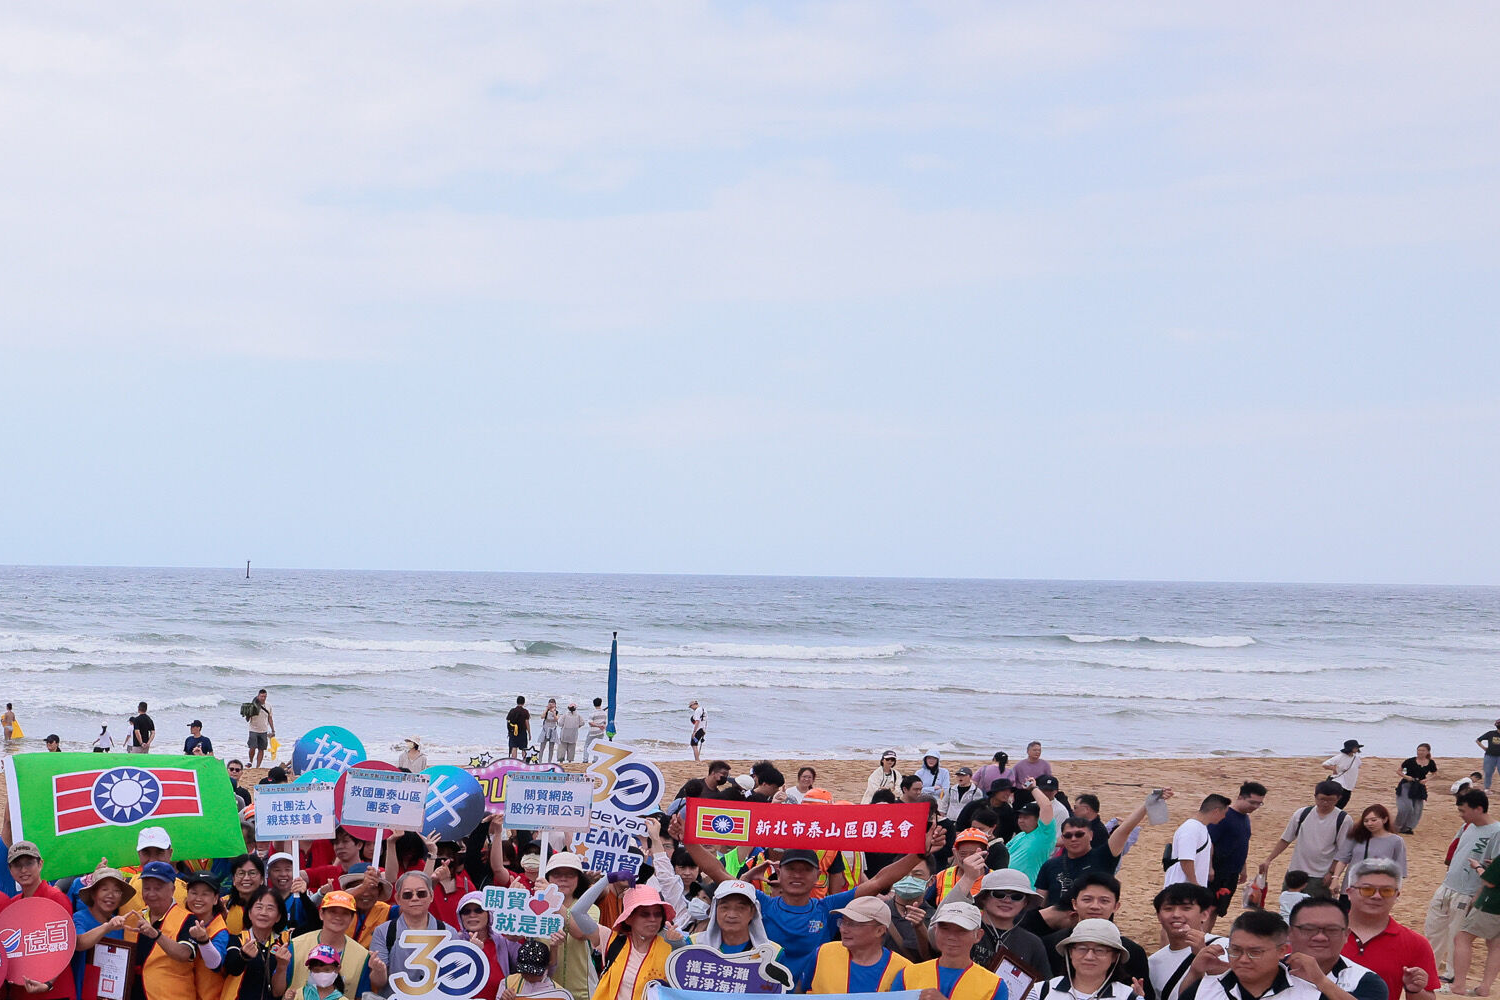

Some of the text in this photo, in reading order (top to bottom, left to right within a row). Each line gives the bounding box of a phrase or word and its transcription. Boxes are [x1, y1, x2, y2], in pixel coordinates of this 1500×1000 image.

[350, 785, 422, 803] 救國團泰山區
[524, 789, 573, 802] 關貿網路
[272, 800, 317, 812] 社團法人
[366, 800, 402, 815] 團委會
[510, 803, 585, 817] 股份有限公司
[266, 813, 323, 826] 親慈慈善會
[756, 819, 915, 839] 新北市泰山區團委會
[485, 889, 527, 911] 關貿
[494, 912, 561, 937] 就是讚
[24, 920, 68, 956] 遠百
[393, 935, 485, 996] 30
[685, 959, 750, 981] 攜手淨灘
